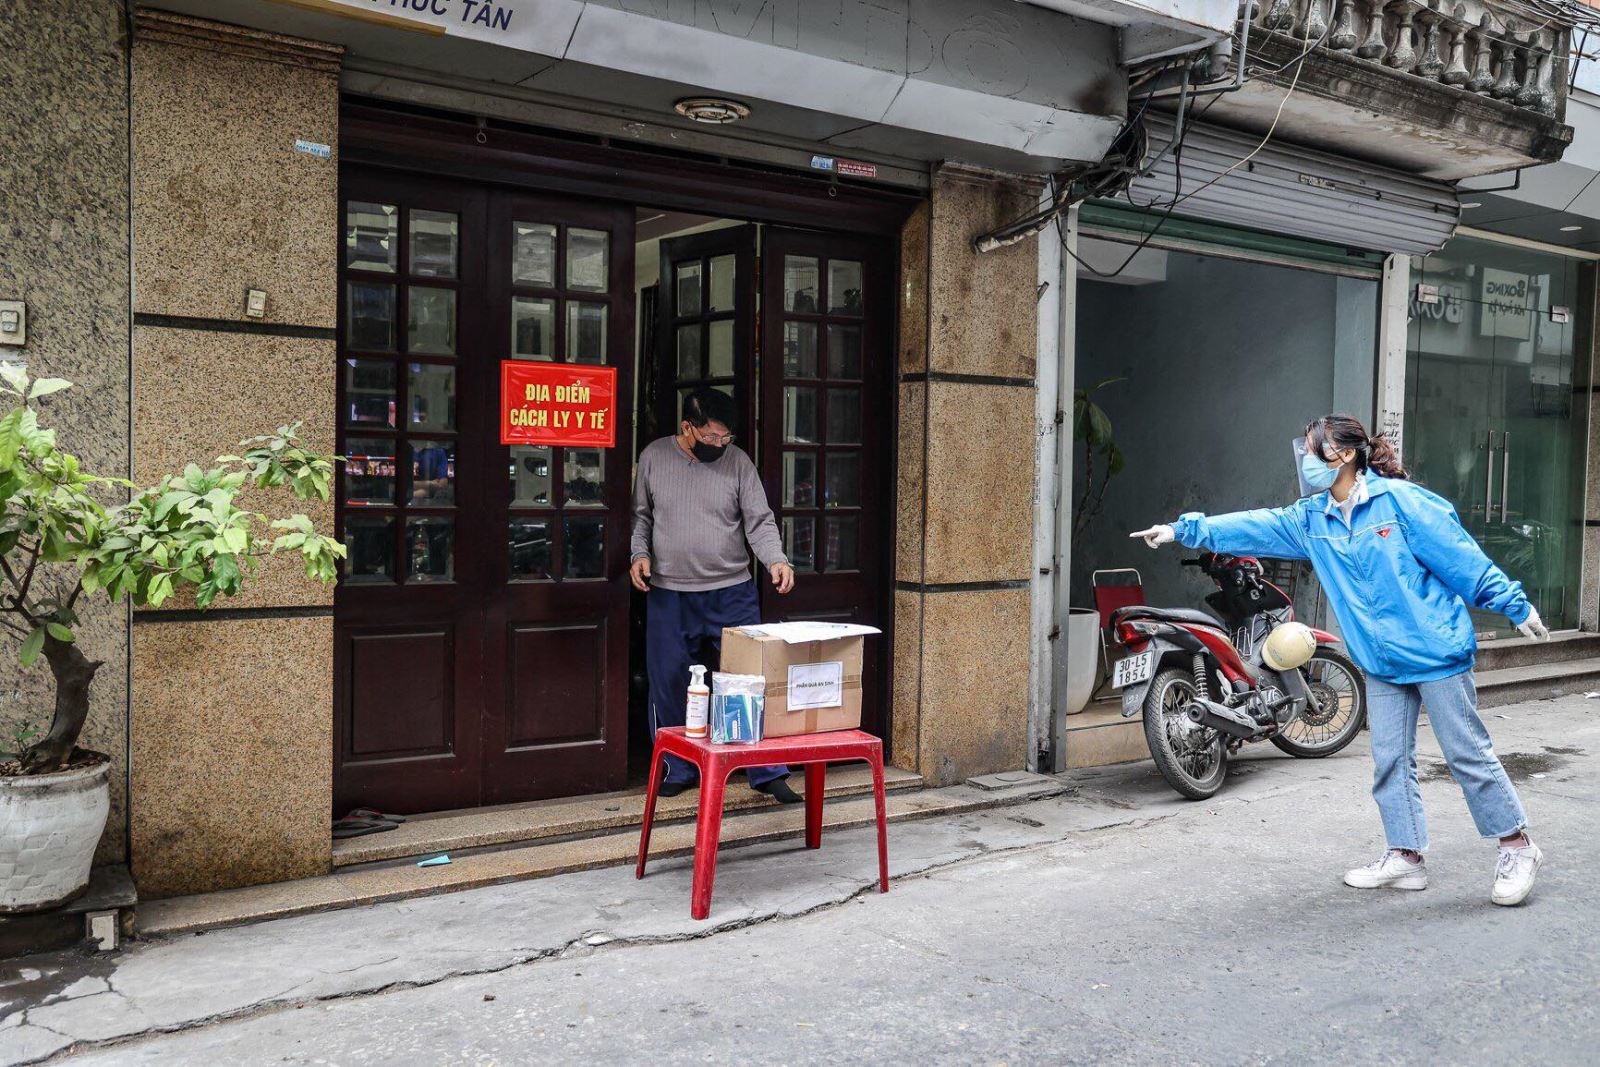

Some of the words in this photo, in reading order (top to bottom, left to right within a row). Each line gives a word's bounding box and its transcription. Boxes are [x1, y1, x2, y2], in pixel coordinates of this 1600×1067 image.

[525, 383, 551, 404] ĐỊA
[555, 380, 590, 404] ĐIỂM
[510, 404, 547, 427] CÁCH
[553, 410, 570, 428] LY
[575, 411, 585, 428] Y
[590, 408, 608, 429] TẾ
[1120, 653, 1147, 673] 30-L5
[1119, 667, 1146, 685] 1854
